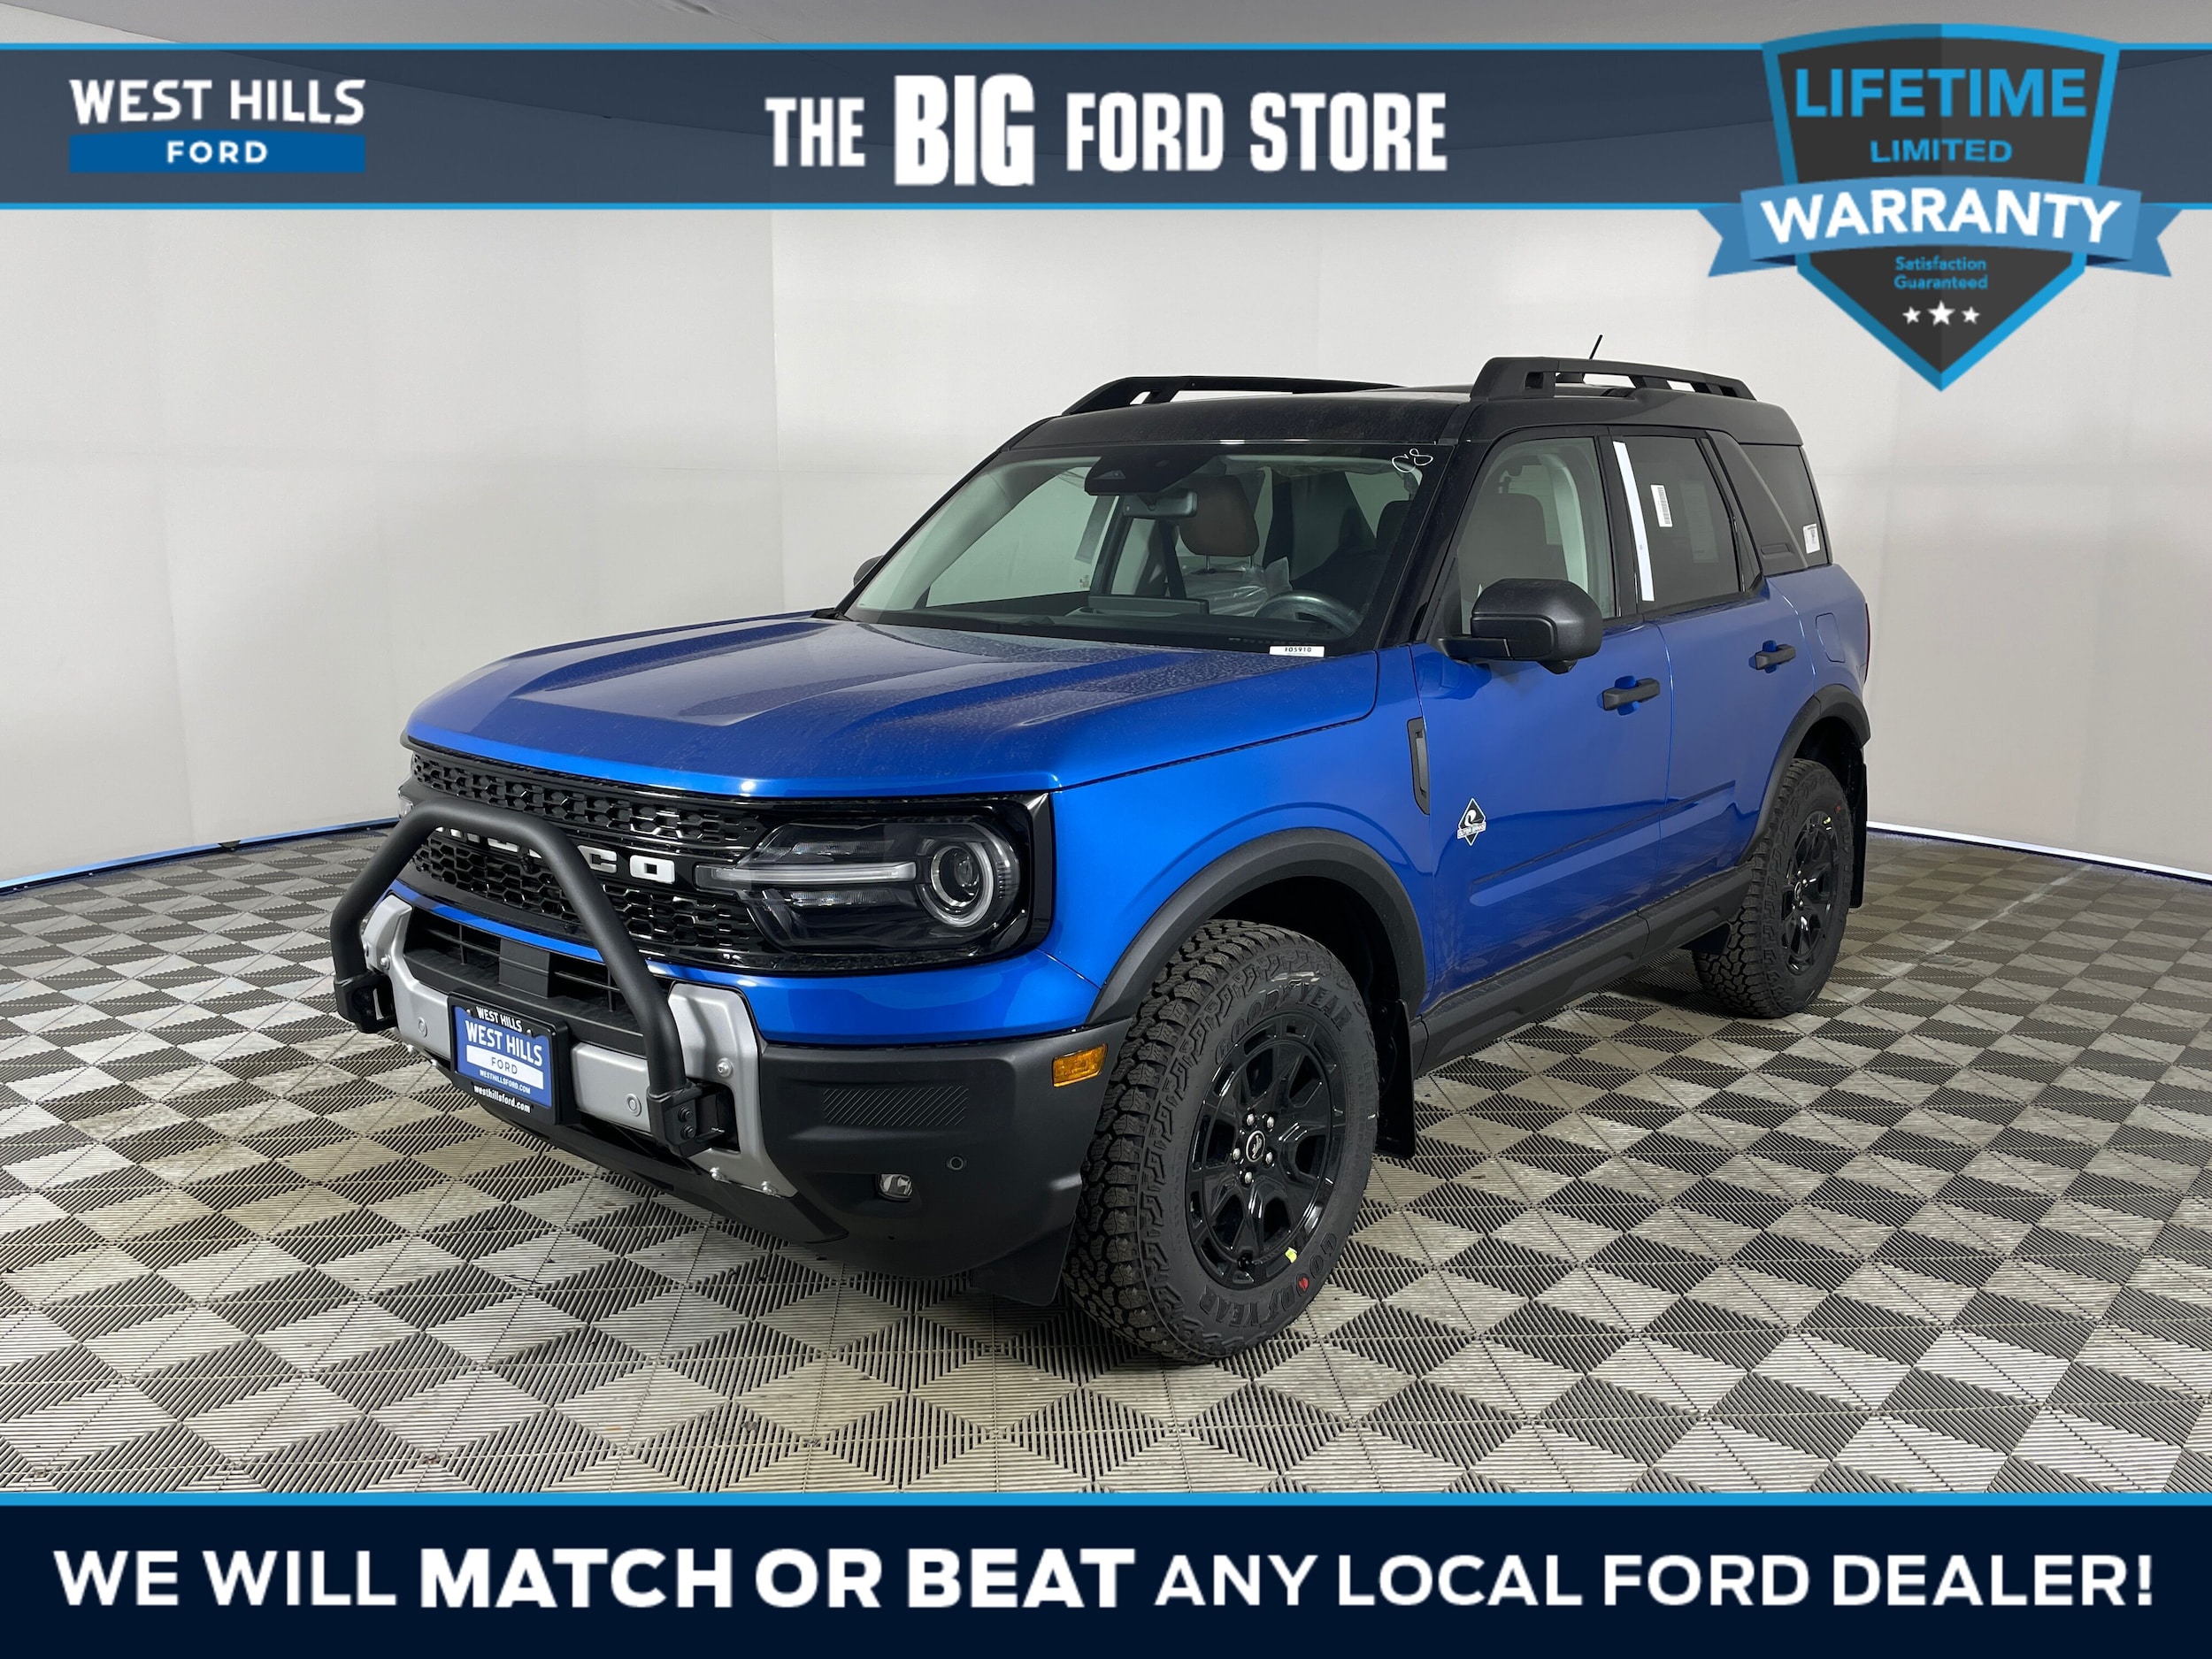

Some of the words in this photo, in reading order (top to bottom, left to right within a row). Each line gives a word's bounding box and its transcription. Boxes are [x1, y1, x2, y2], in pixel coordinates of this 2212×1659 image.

[475, 1005, 499, 1023] WEST
[500, 1014, 523, 1033] HILLS
[465, 1019, 503, 1050] WEST
[506, 1034, 543, 1067] HILLS
[491, 1056, 518, 1075] FORD
[479, 1069, 531, 1094] WESTHILLSFORD.COM
[473, 1085, 531, 1114] westhillsford.com
